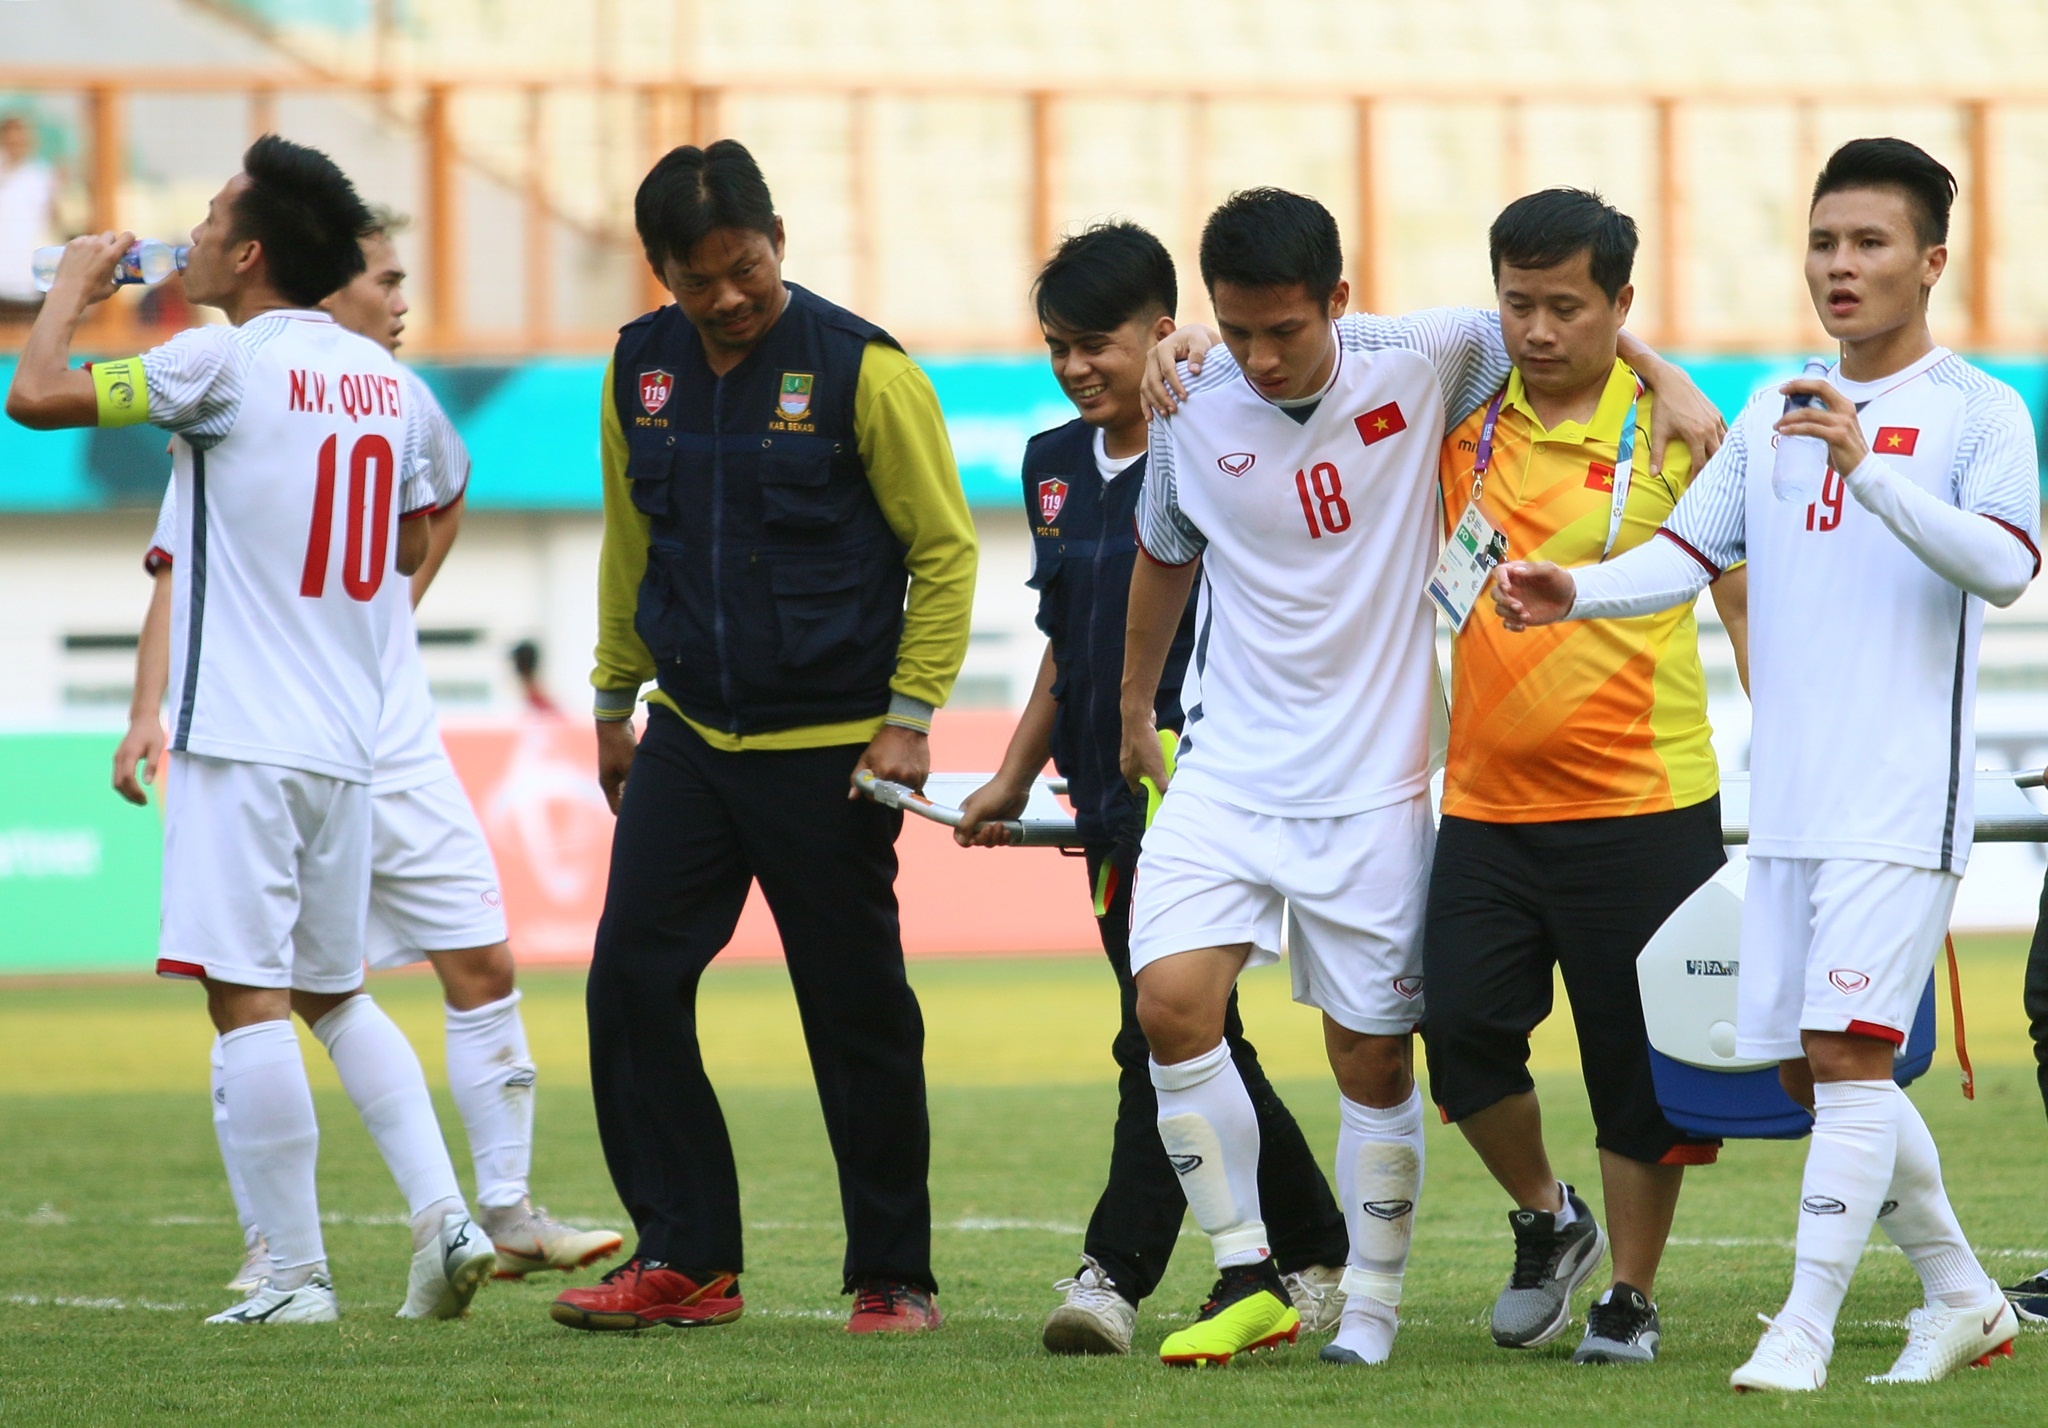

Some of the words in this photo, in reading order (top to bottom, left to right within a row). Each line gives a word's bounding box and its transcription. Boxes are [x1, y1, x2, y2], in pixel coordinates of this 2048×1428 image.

[288, 369, 334, 415] N.V.
[339, 373, 402, 424] QUYET
[643, 385, 667, 401] 119
[635, 416, 652, 427] PSC
[653, 418, 669, 428] 119
[1041, 493, 1061, 510] 119
[1295, 461, 1352, 540] 18
[299, 432, 394, 602] 10
[1458, 526, 1470, 542] FO
[1485, 553, 1499, 568] FOP
